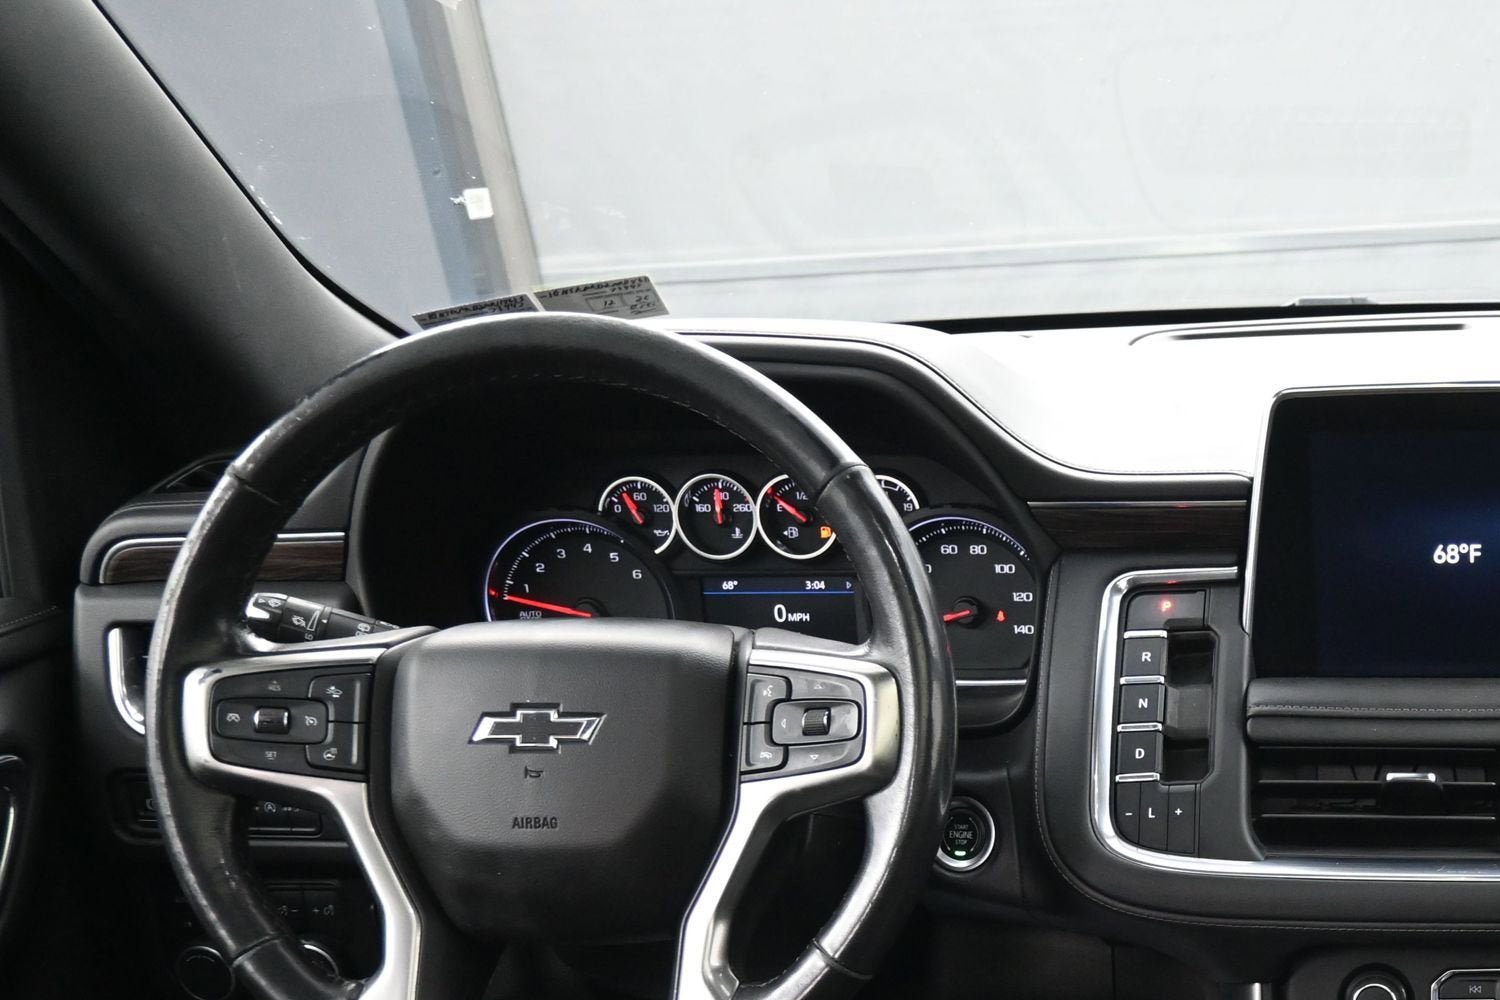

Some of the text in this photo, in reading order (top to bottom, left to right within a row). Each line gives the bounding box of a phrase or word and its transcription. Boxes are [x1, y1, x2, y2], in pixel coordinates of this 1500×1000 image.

[633, 492, 647, 501] 60
[614, 504, 622, 513] 0
[653, 504, 670, 513] 120
[695, 504, 711, 513] 160
[733, 504, 753, 513] 260
[777, 504, 783, 512] E
[903, 502, 913, 512] 19
[583, 543, 592, 553] 4
[941, 544, 958, 554] 60
[970, 544, 987, 554] 80
[556, 549, 566, 558] 3
[610, 553, 619, 562] 5
[1433, 543, 1482, 564] 68°F
[536, 563, 545, 573] 2
[994, 564, 1015, 574] 100
[632, 569, 642, 579] 6
[524, 584, 529, 593] 1
[722, 580, 738, 590] 68°
[805, 580, 825, 590] 3:04
[1012, 592, 1033, 602] 120
[1162, 601, 1171, 611] P
[774, 604, 810, 622] 0 MPH
[1014, 625, 1035, 635] 140
[1141, 651, 1152, 662] R
[1138, 698, 1148, 708] N
[1135, 748, 1145, 759] D
[1148, 807, 1156, 818] L
[512, 816, 558, 829] AIRBAG
[949, 831, 973, 839] ENGINE
